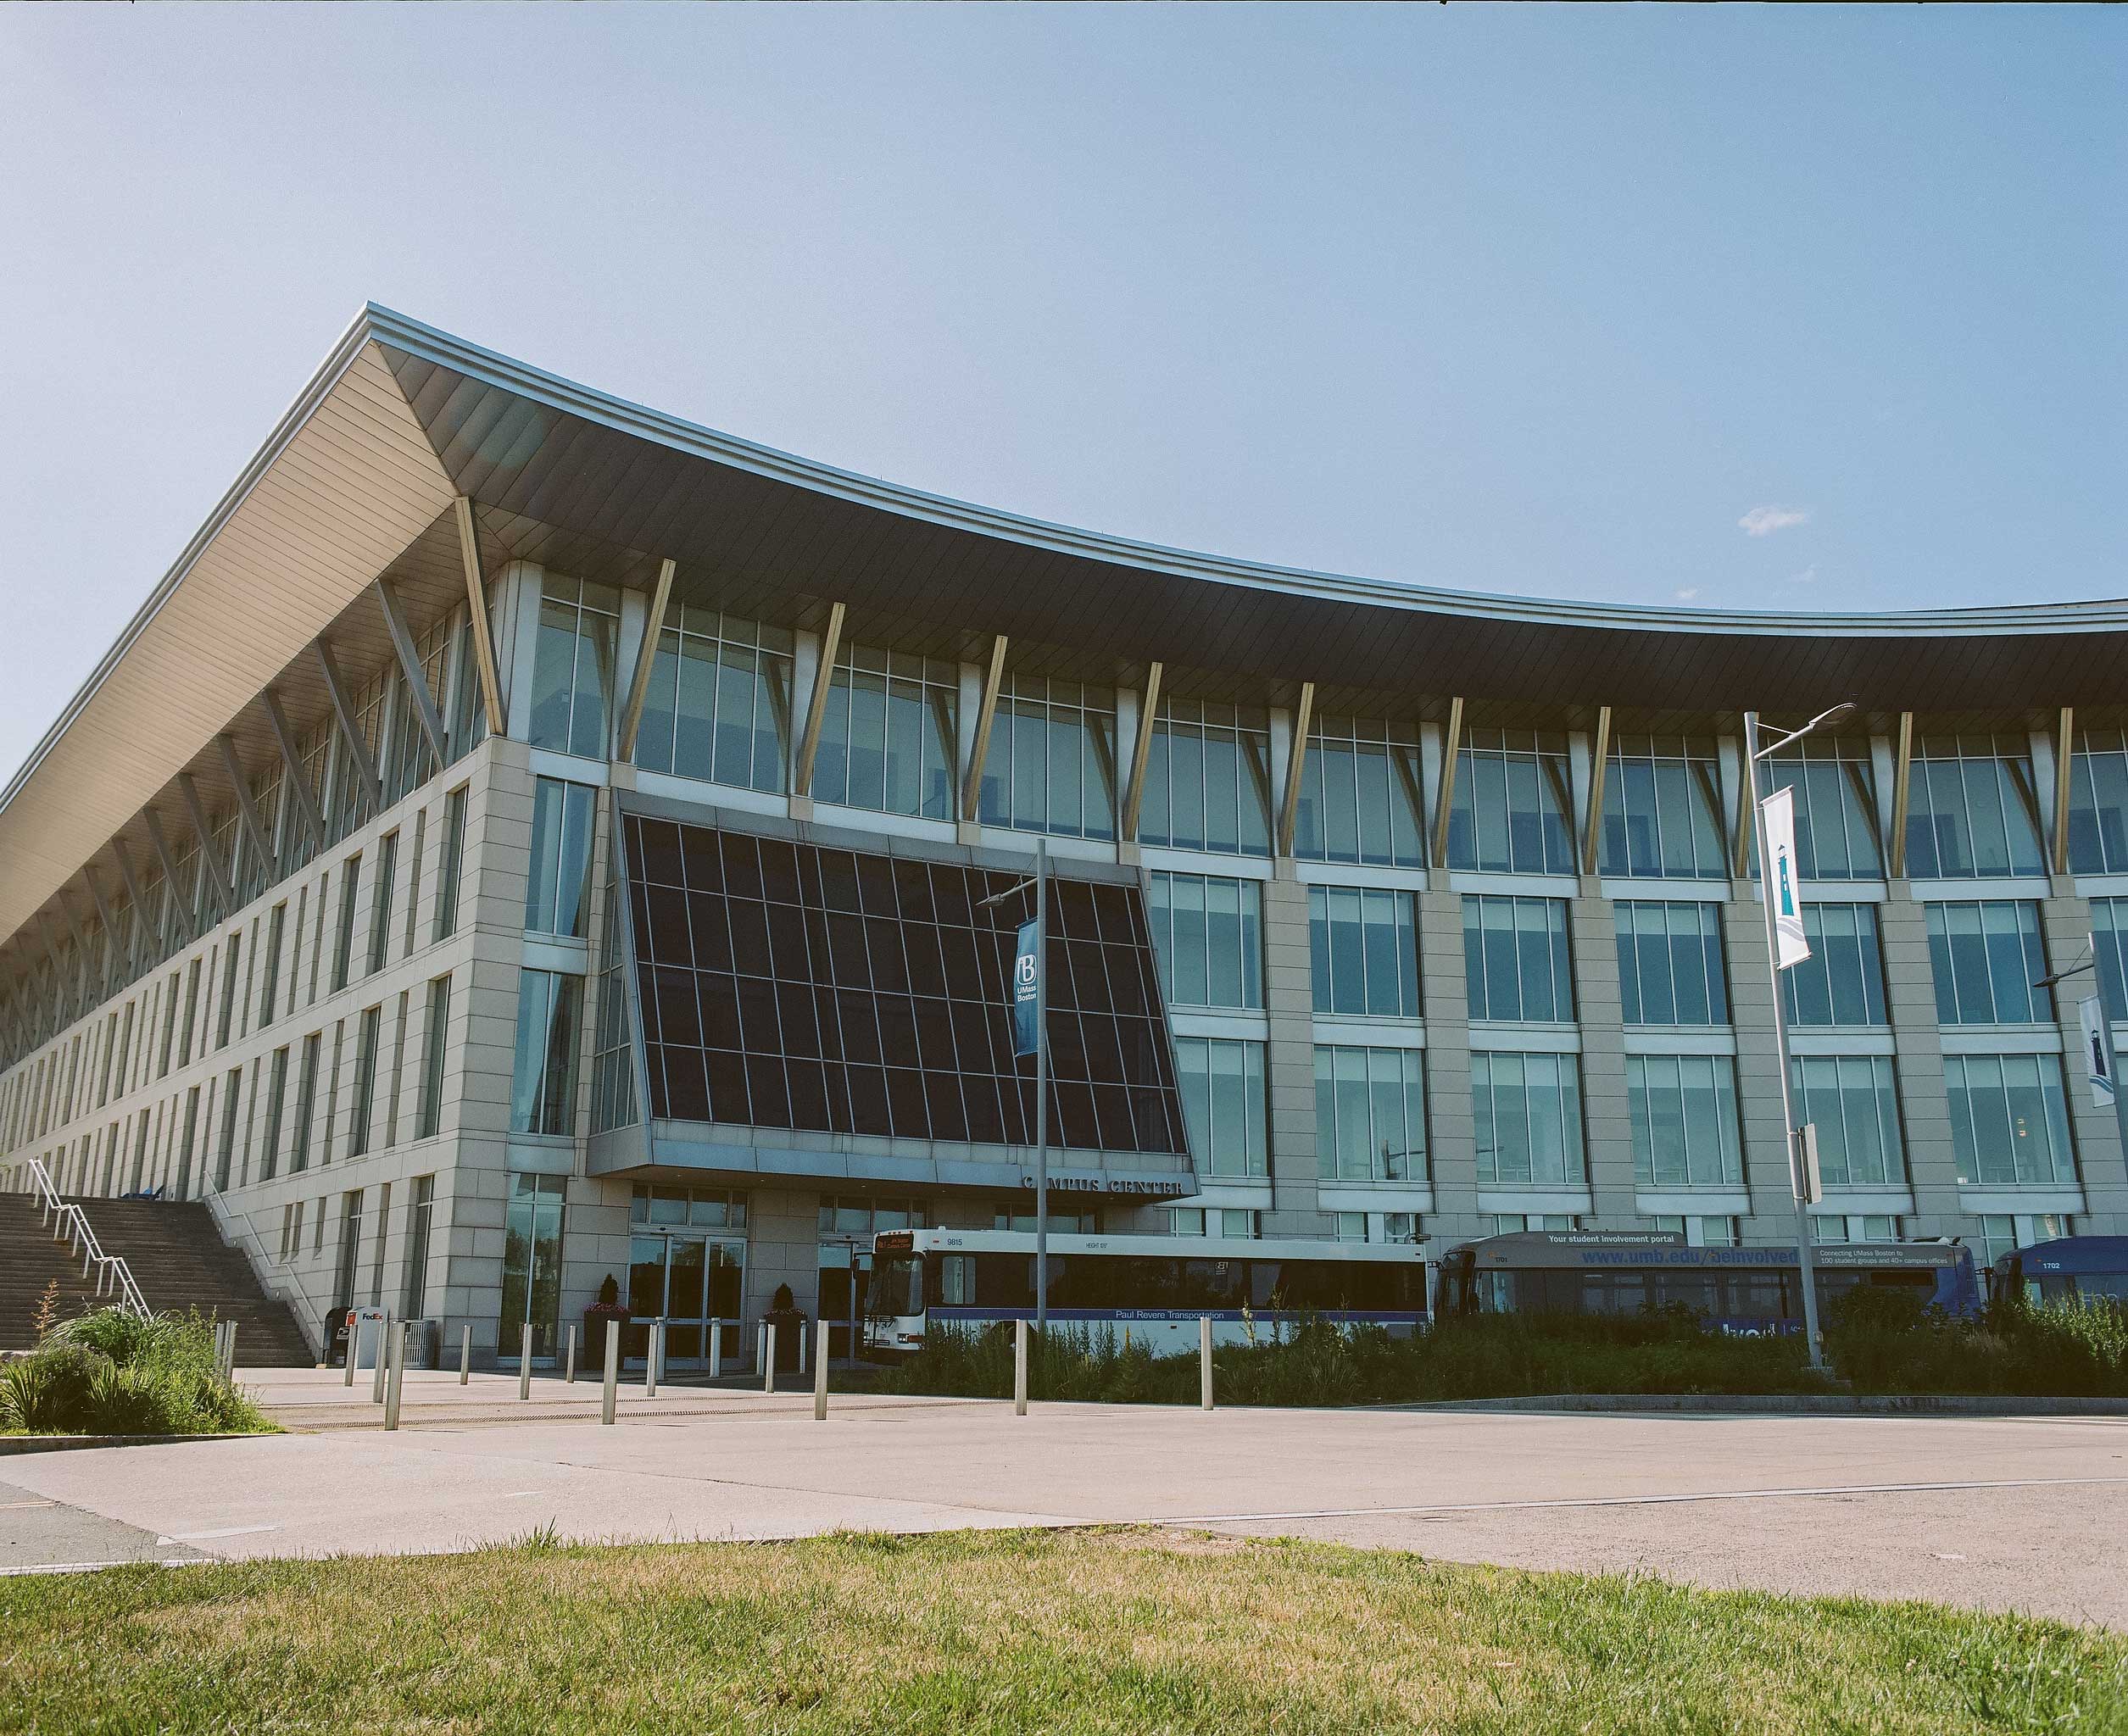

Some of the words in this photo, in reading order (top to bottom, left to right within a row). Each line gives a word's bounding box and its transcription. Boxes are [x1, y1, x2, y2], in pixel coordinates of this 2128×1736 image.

[1017, 986, 1037, 994] UMass
[1017, 993, 1037, 1002] Boston
[1023, 1177, 1100, 1191] CMPUS
[1111, 1181, 1184, 1194] CENTER
[1549, 1235, 1567, 1244] Your
[1568, 1235, 1600, 1244] student
[1651, 1235, 1674, 1244] portal
[1819, 1249, 1852, 1258] Connecting
[1116, 1310, 1134, 1319] Paul
[1137, 1310, 1166, 1319] Revere
[1167, 1310, 1224, 1321] Transportation
